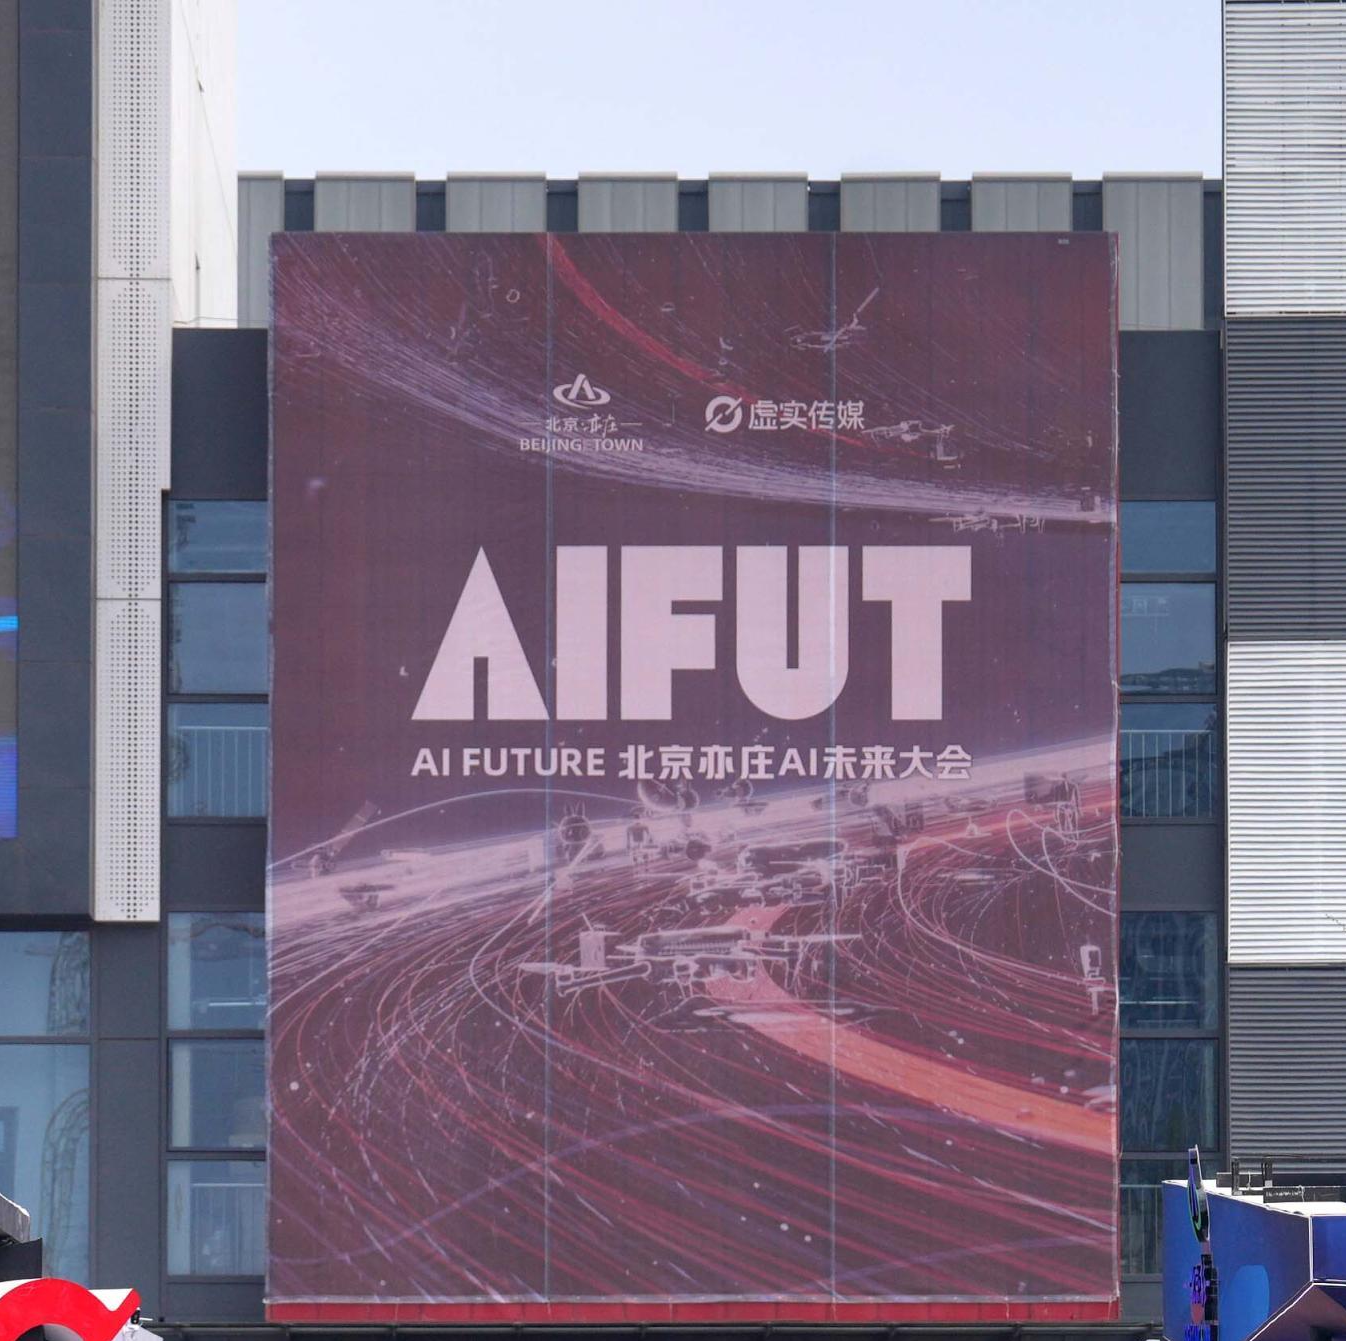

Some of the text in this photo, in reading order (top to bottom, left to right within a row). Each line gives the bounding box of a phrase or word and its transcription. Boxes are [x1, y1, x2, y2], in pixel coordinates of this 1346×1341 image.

[749, 400, 865, 431] 虚实传媒
[411, 546, 972, 720] AIFUT
[411, 744, 973, 780] AI FUTURE 北京亦庄AI未来大会
